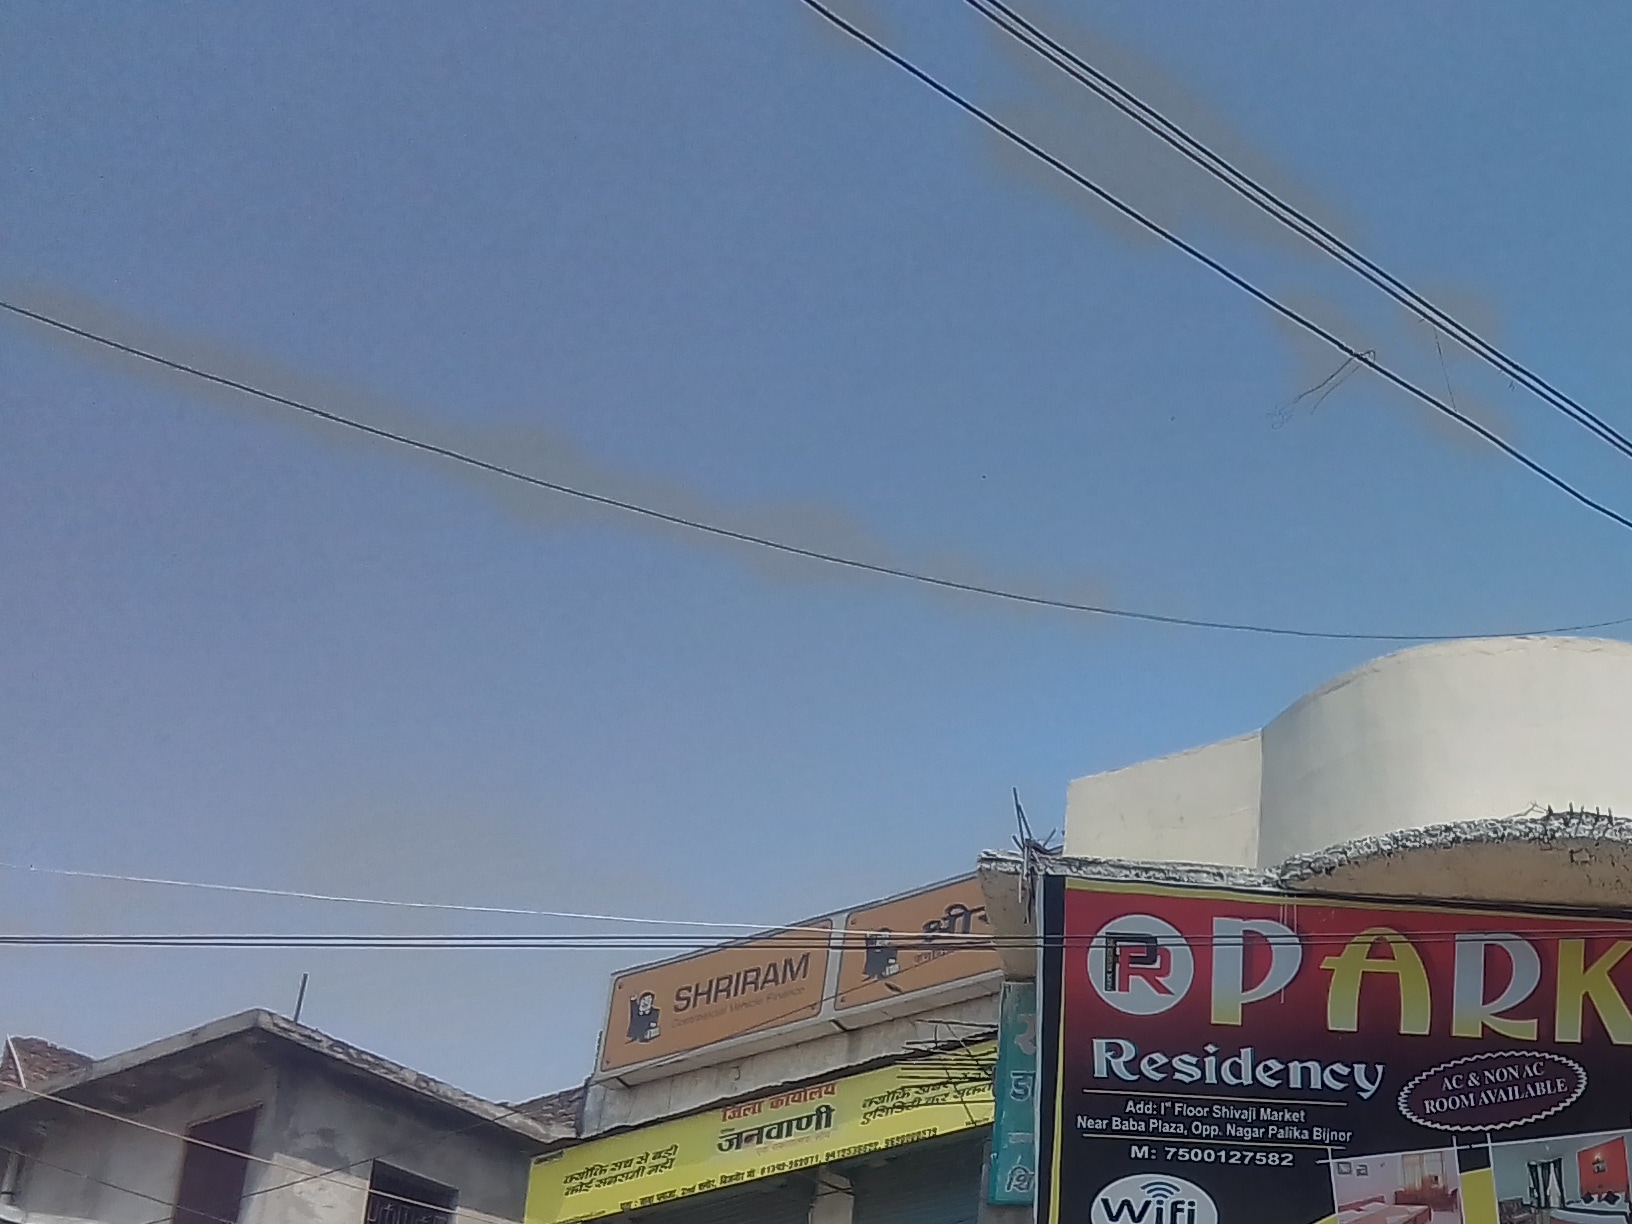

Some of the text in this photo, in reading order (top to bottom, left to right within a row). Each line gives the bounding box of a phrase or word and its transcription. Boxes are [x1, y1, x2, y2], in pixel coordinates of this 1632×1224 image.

[673, 953, 811, 1014] SHRIRAM
[1091, 1038, 1386, 1099] Residency
[1441, 1061, 1546, 1092] AC & NON AC
[1125, 1100, 1158, 1115] Add:
[1174, 1103, 1210, 1118] Floor
[1212, 1105, 1258, 1122] Shivaji
[1259, 1107, 1306, 1123] Market
[1423, 1078, 1569, 1115] ROOM AVAILABLE
[716, 1104, 835, 1153] जनवाणी
[1076, 1115, 1353, 1143] Near Baba Plaza, Opp. Nagar Palika Bijnor
[1130, 1145, 1295, 1166] M: 7500127582
